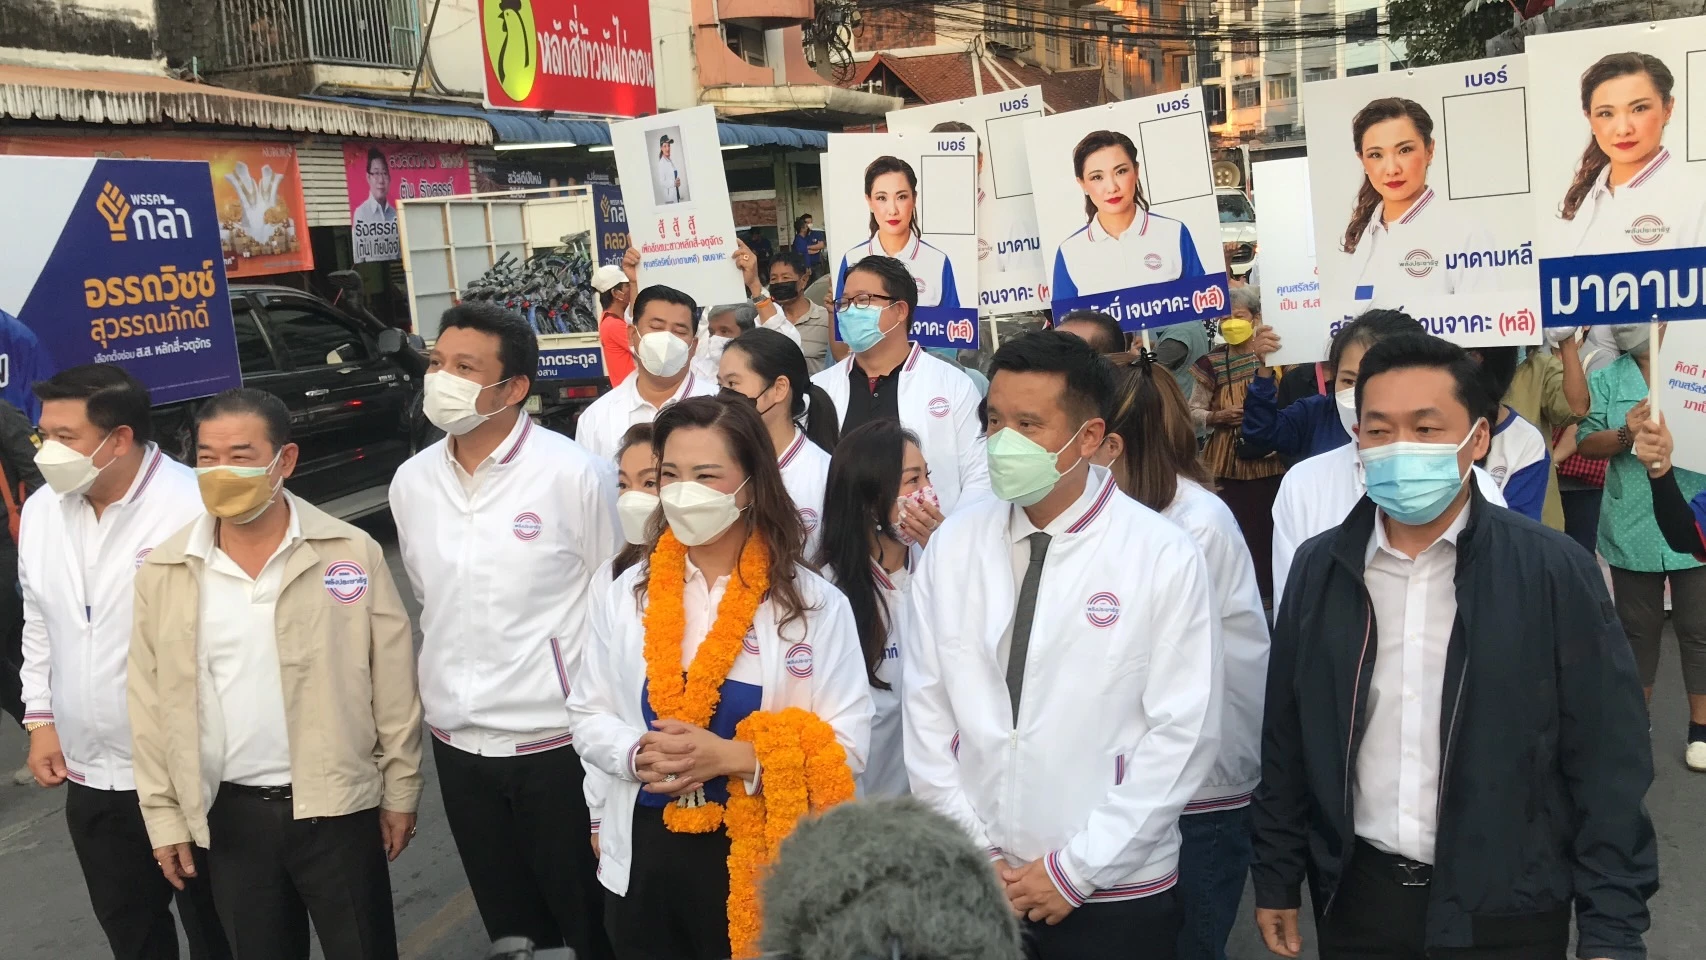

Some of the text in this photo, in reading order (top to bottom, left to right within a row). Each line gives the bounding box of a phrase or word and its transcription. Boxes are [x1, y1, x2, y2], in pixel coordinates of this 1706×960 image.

[537, 4, 654, 88] หลักสี่ข้าวมันไก่ตอน
[1465, 64, 1508, 88] เบอร์
[1000, 94, 1029, 112] เบอร์
[1157, 94, 1190, 114] เบอร์
[937, 137, 966, 151] เบอร์
[130, 194, 161, 205] พรรค
[355, 218, 398, 237] รังสรรค์
[658, 219, 666, 239] สู้
[688, 215, 696, 235] สู้
[997, 236, 1041, 255] มาดาม
[1446, 240, 1533, 270] มาดามหลี
[84, 259, 216, 309] อรรถวิชช์
[1551, 267, 1706, 316] มาดาม
[1126, 295, 1190, 320] เจนจาคะ
[1191, 284, 1225, 315] (หลี)
[1280, 298, 1298, 311] เป็น
[90, 300, 210, 349] สุวรรณภักดี
[909, 319, 974, 342] จาคะ (หลี)
[1416, 313, 1492, 335] จนจาคะ
[1498, 308, 1536, 337] (หลี)
[537, 353, 598, 369] าภตระกูล
